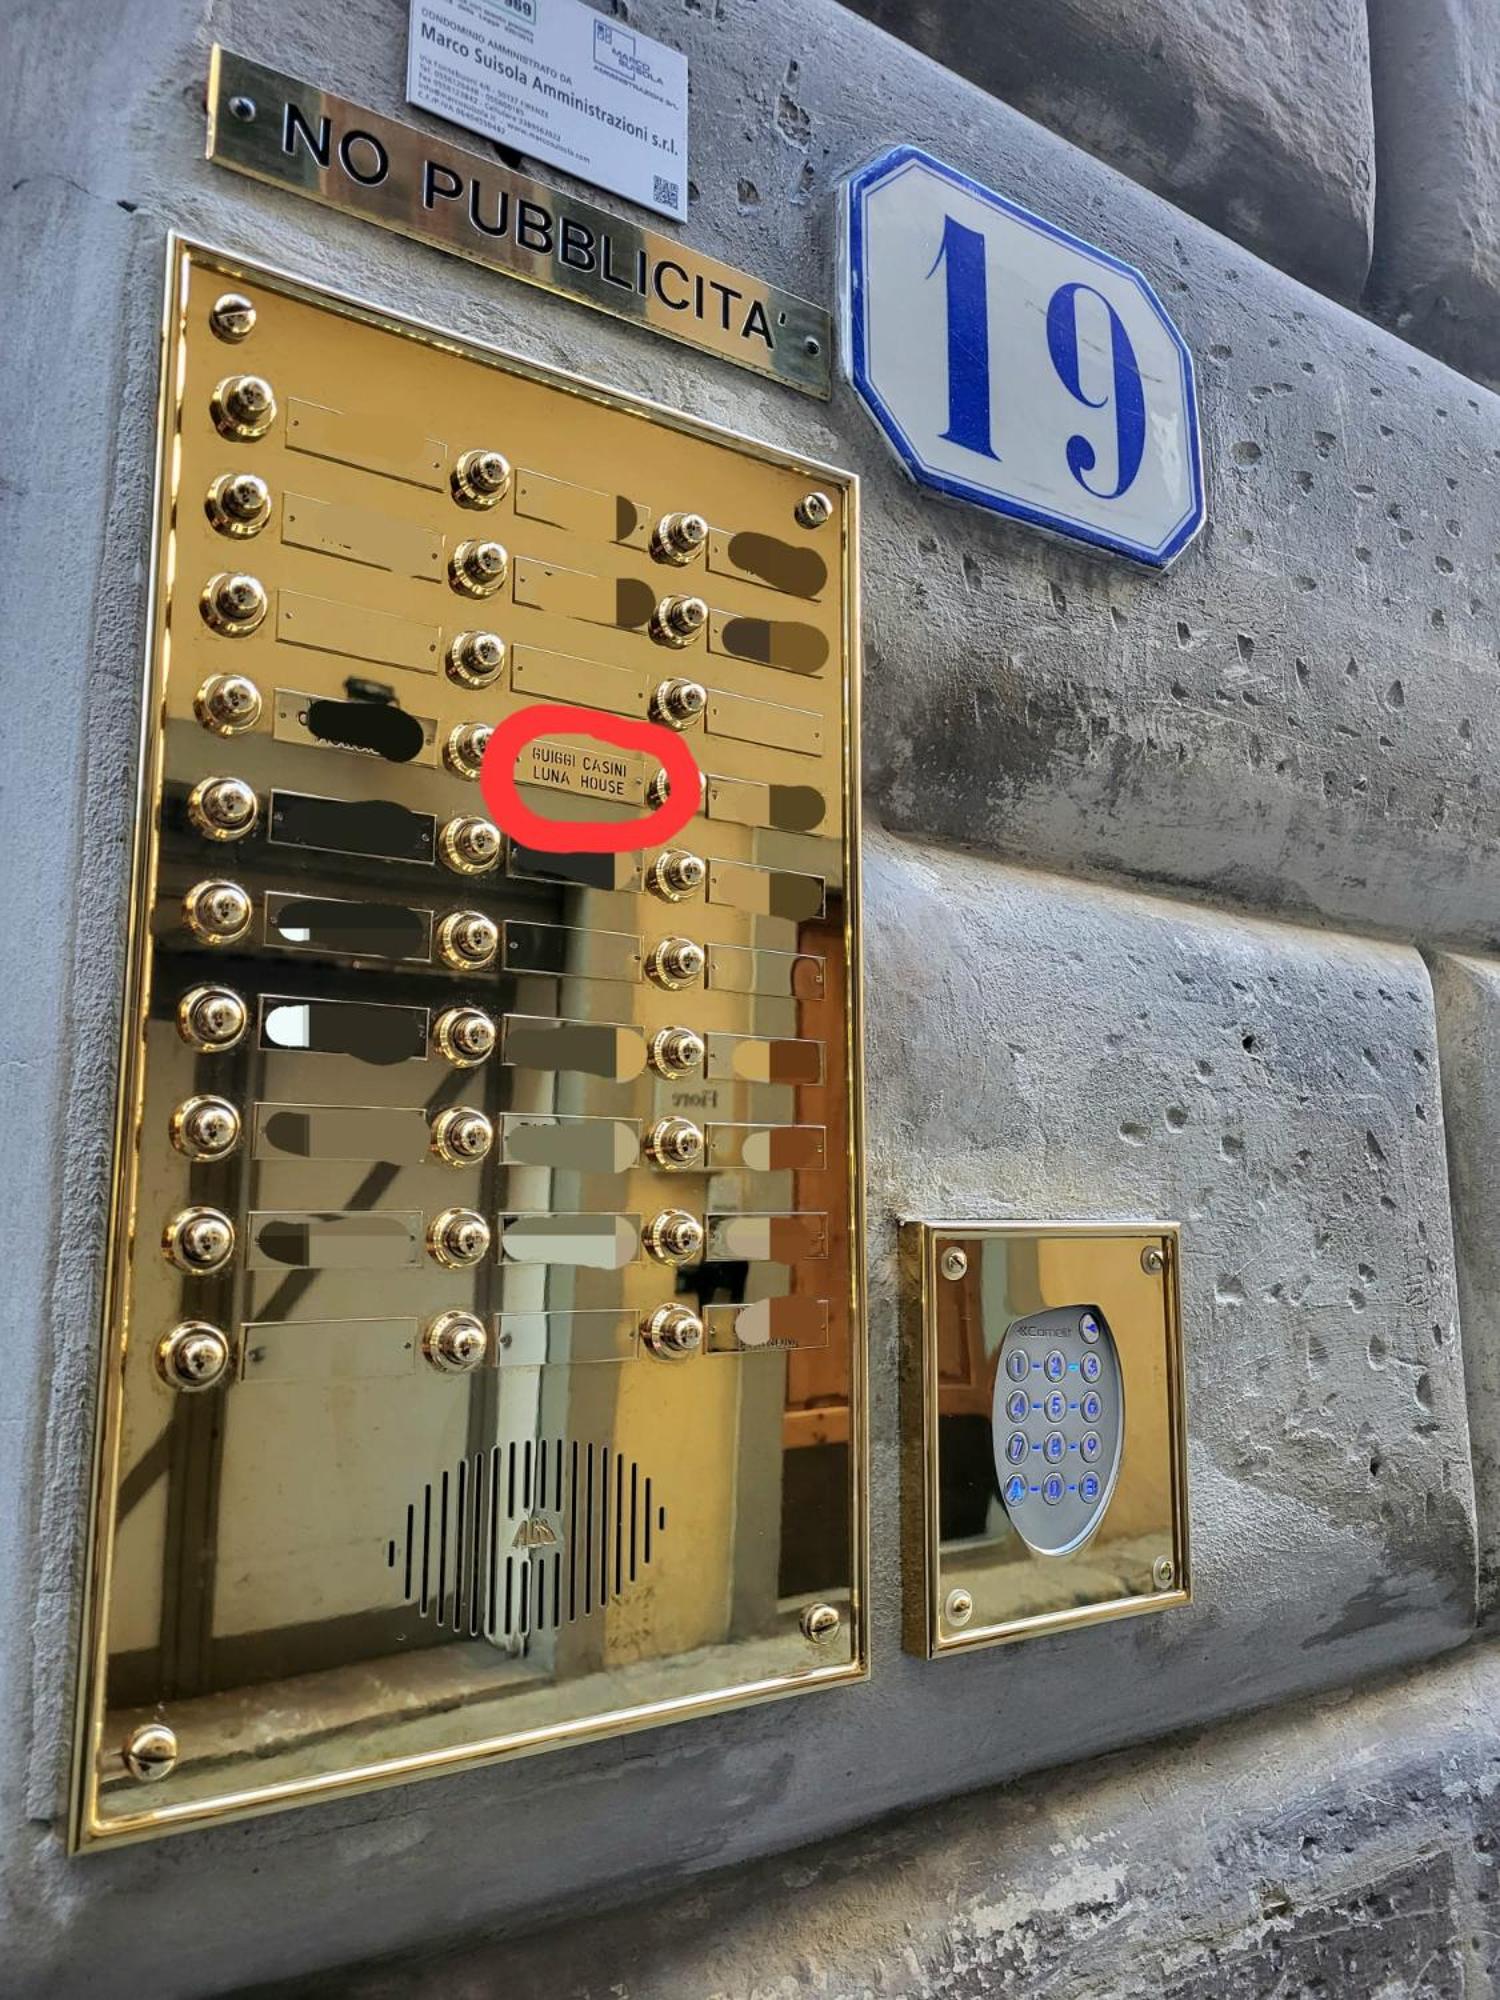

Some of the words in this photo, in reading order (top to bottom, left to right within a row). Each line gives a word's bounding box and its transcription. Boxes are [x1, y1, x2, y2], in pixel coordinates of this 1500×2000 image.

[420, 6, 485, 45] CONDOMINIO
[486, 37, 557, 79] AMMINISTRATO
[558, 71, 572, 86] DA
[420, 20, 469, 59] Marco
[473, 45, 528, 86] Suisola
[531, 72, 648, 143] Amministrazioni
[651, 129, 678, 157] s.r.l.
[282, 102, 389, 187] NO
[423, 159, 786, 350] PUBBLICITA'
[925, 214, 1145, 499] 19
[533, 765, 570, 786] LUNA
[580, 775, 625, 796] HOUSE
[583, 757, 627, 778] CASINI
